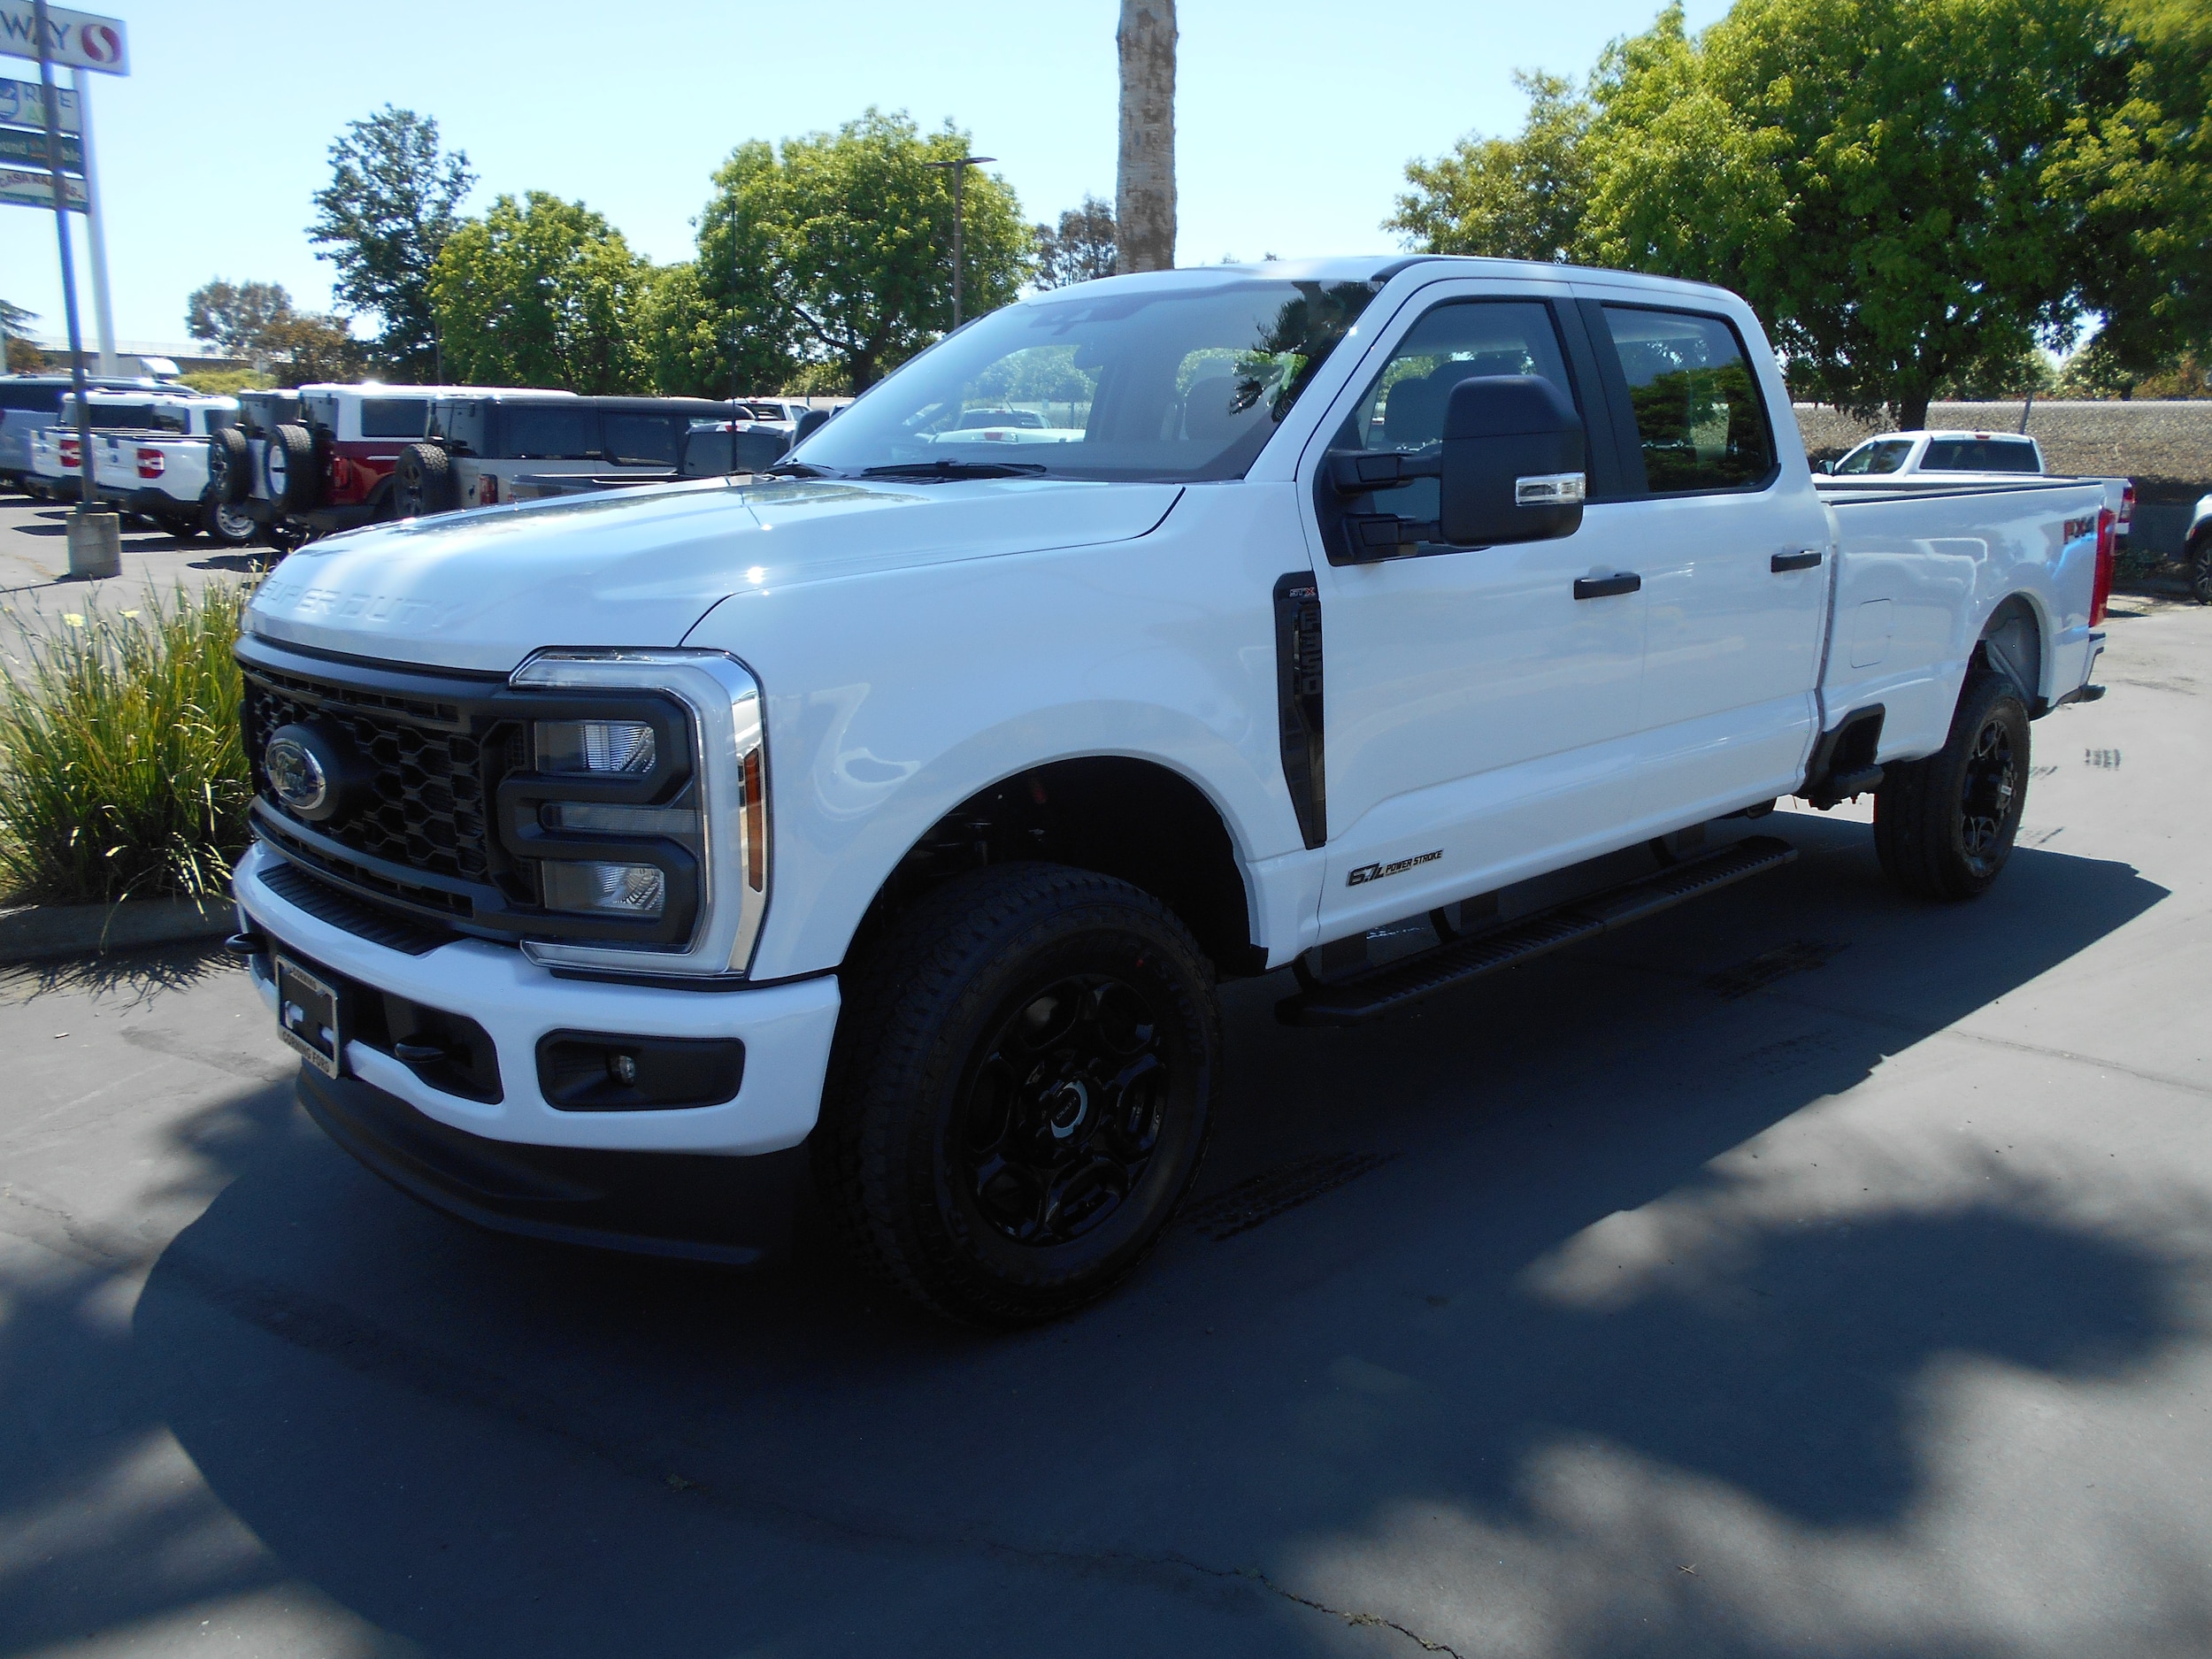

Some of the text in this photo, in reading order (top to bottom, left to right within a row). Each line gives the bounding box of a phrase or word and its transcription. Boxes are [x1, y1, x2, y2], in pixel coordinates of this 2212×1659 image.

[0, 9, 71, 50] WY
[2063, 516, 2094, 545] FX4
[1289, 587, 1316, 597] STX
[1348, 862, 1384, 887] 6.7L
[1386, 858, 1413, 873] POWER
[1413, 849, 1443, 865] STROKE
[312, 1051, 330, 1073] FORD
